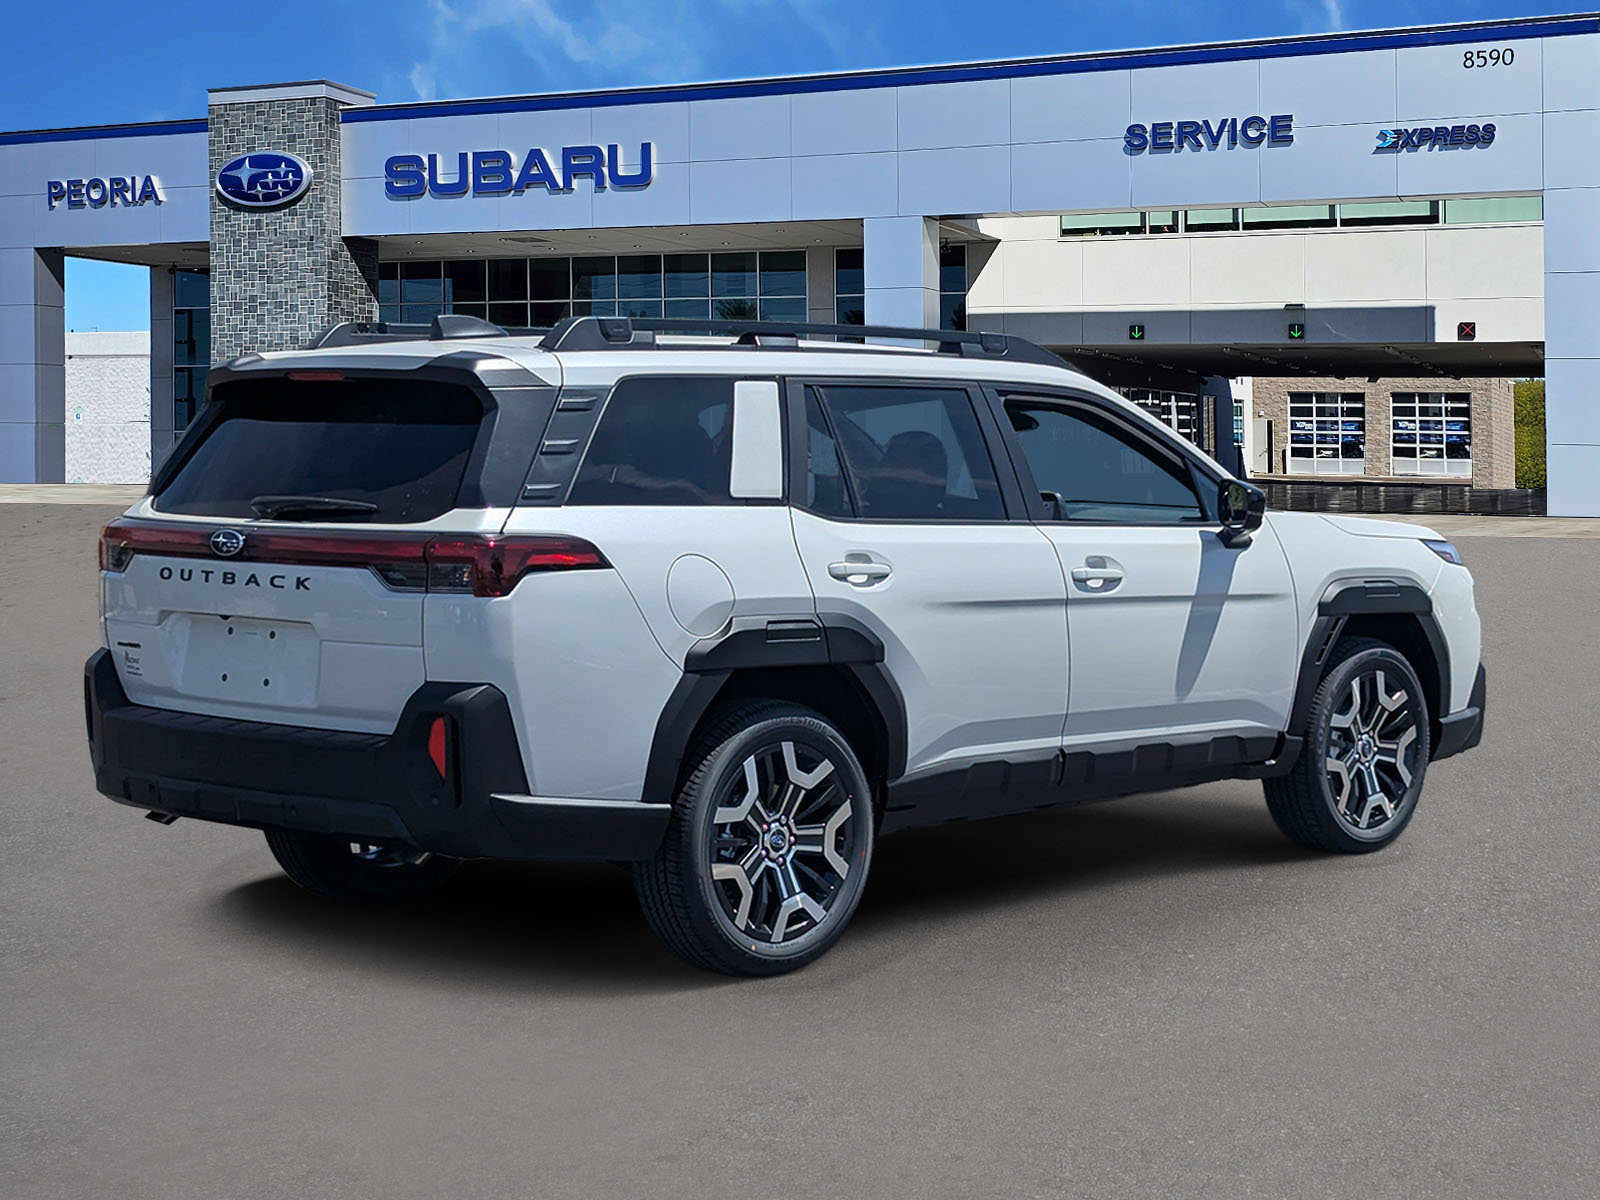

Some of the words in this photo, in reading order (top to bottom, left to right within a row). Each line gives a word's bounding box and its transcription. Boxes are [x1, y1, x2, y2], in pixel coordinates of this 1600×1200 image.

[1463, 48, 1515, 69] 8590
[1124, 114, 1294, 153] SERVICE
[1376, 123, 1497, 150] EXPRESS
[384, 142, 653, 197] SUBARU
[47, 175, 163, 208] PEORIA
[158, 566, 311, 591] OUTBACK
